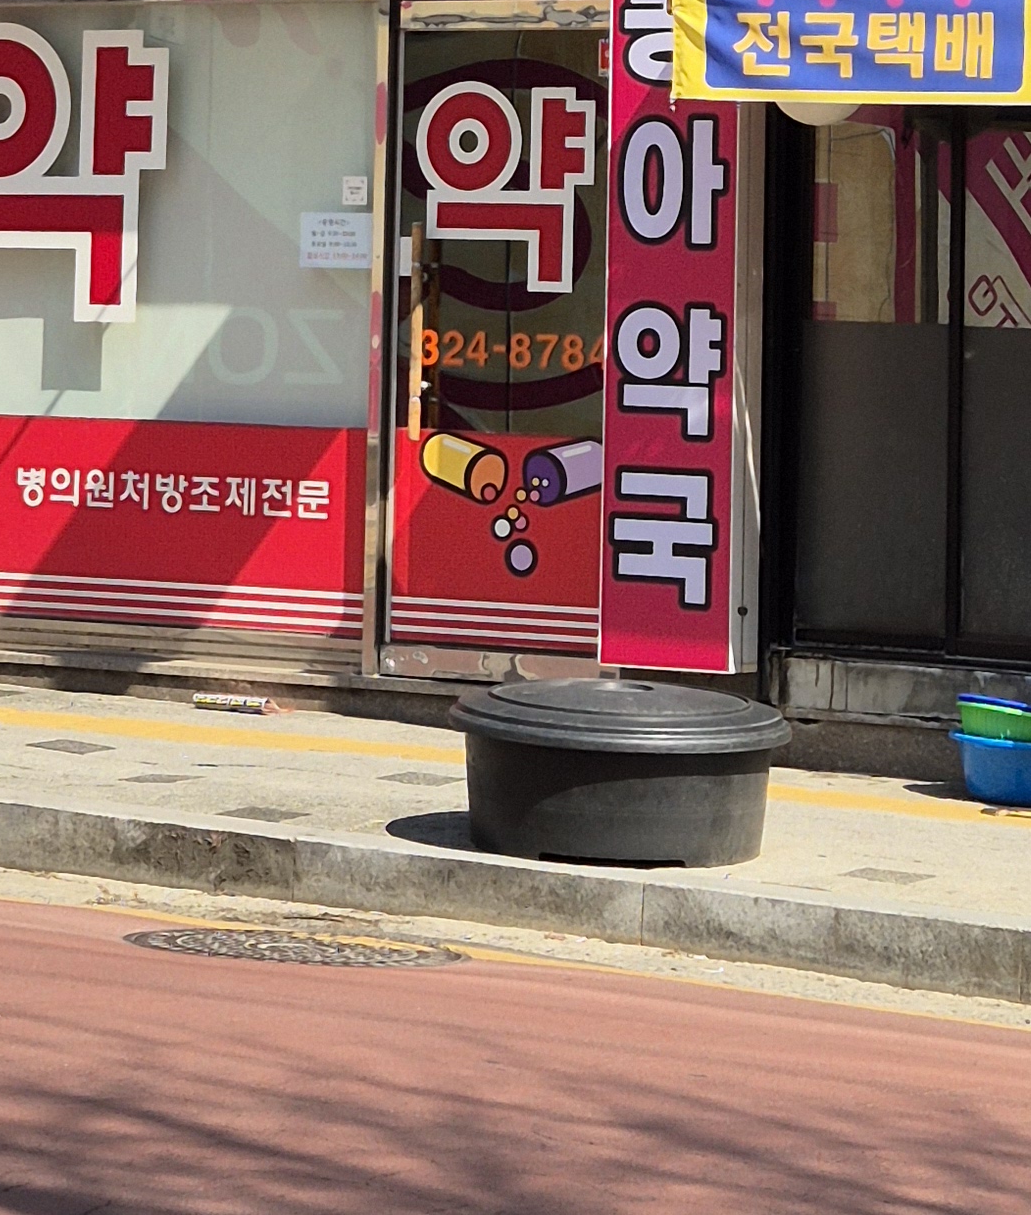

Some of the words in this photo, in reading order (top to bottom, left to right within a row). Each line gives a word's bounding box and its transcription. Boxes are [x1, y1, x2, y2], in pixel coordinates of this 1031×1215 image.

[732, 11, 994, 79] 전국택배
[416, 81, 596, 293] 약
[16, 466, 331, 521] 병의원처방조제전문
